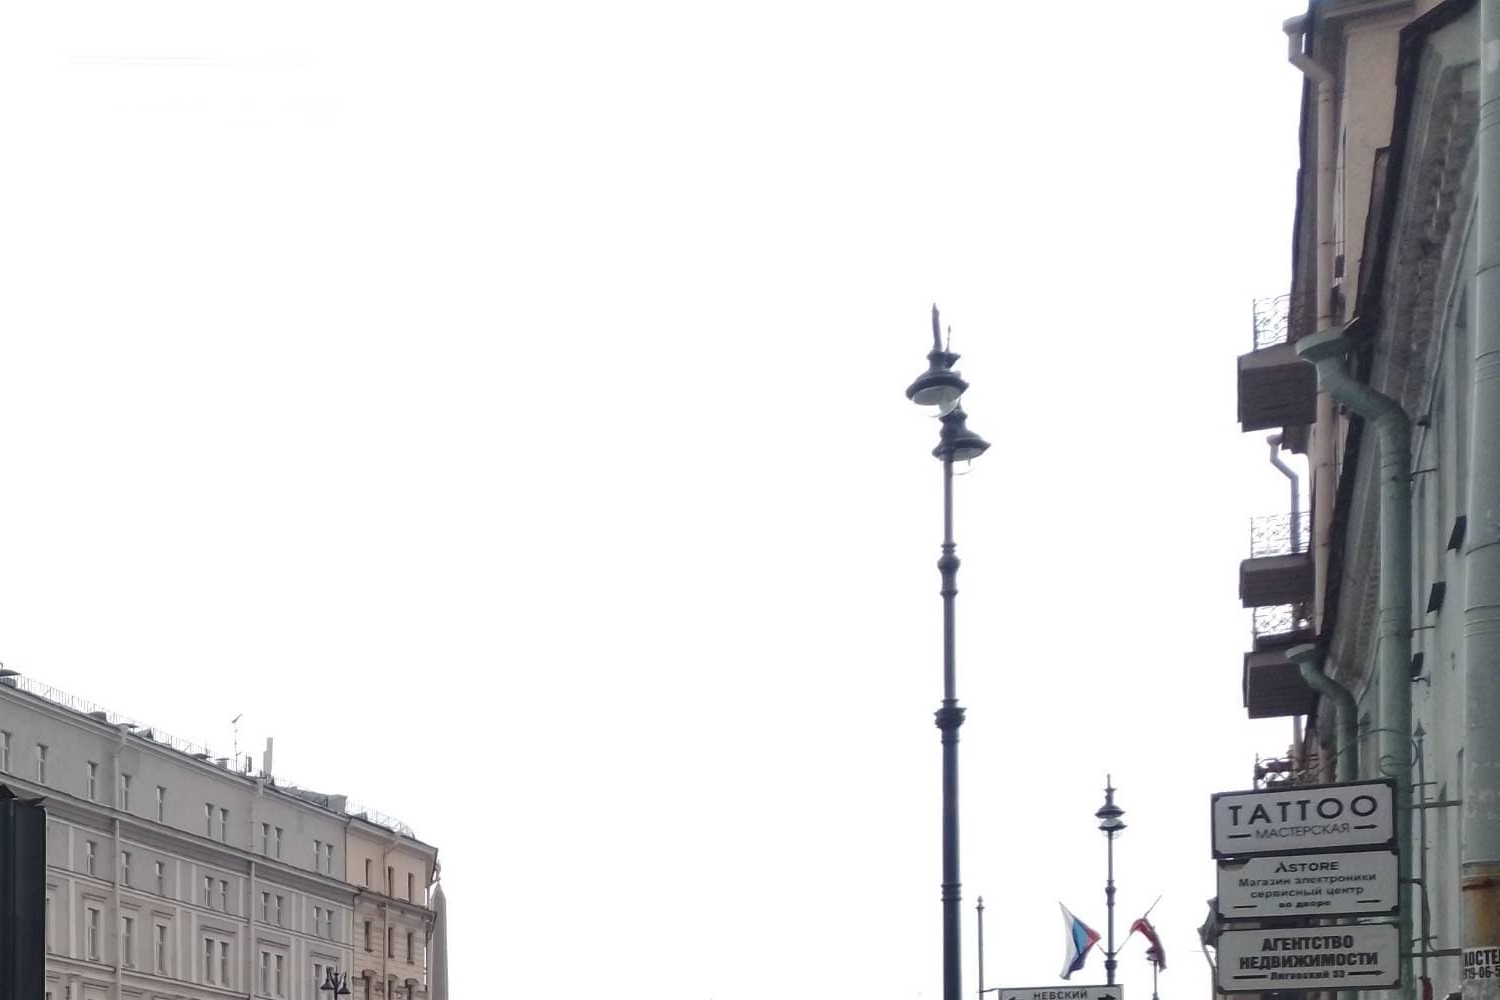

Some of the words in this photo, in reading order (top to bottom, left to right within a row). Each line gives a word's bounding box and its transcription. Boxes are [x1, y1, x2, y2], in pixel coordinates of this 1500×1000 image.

[1228, 795, 1377, 826] TATTOO
[1255, 823, 1349, 839] МАСТЕРСКАЯ
[1239, 877, 1291, 888] Магазин
[1295, 873, 1377, 886] электроники
[1251, 887, 1322, 899] сервисный
[1326, 885, 1364, 898] центр
[1278, 901, 1292, 909] во
[1296, 900, 1331, 909] дворе
[1262, 935, 1354, 952] АГЕНТСТВО
[1239, 952, 1379, 970] НЕДВИЖИМОСТИ
[1033, 990, 1088, 1000] НЕВСКИЙ
